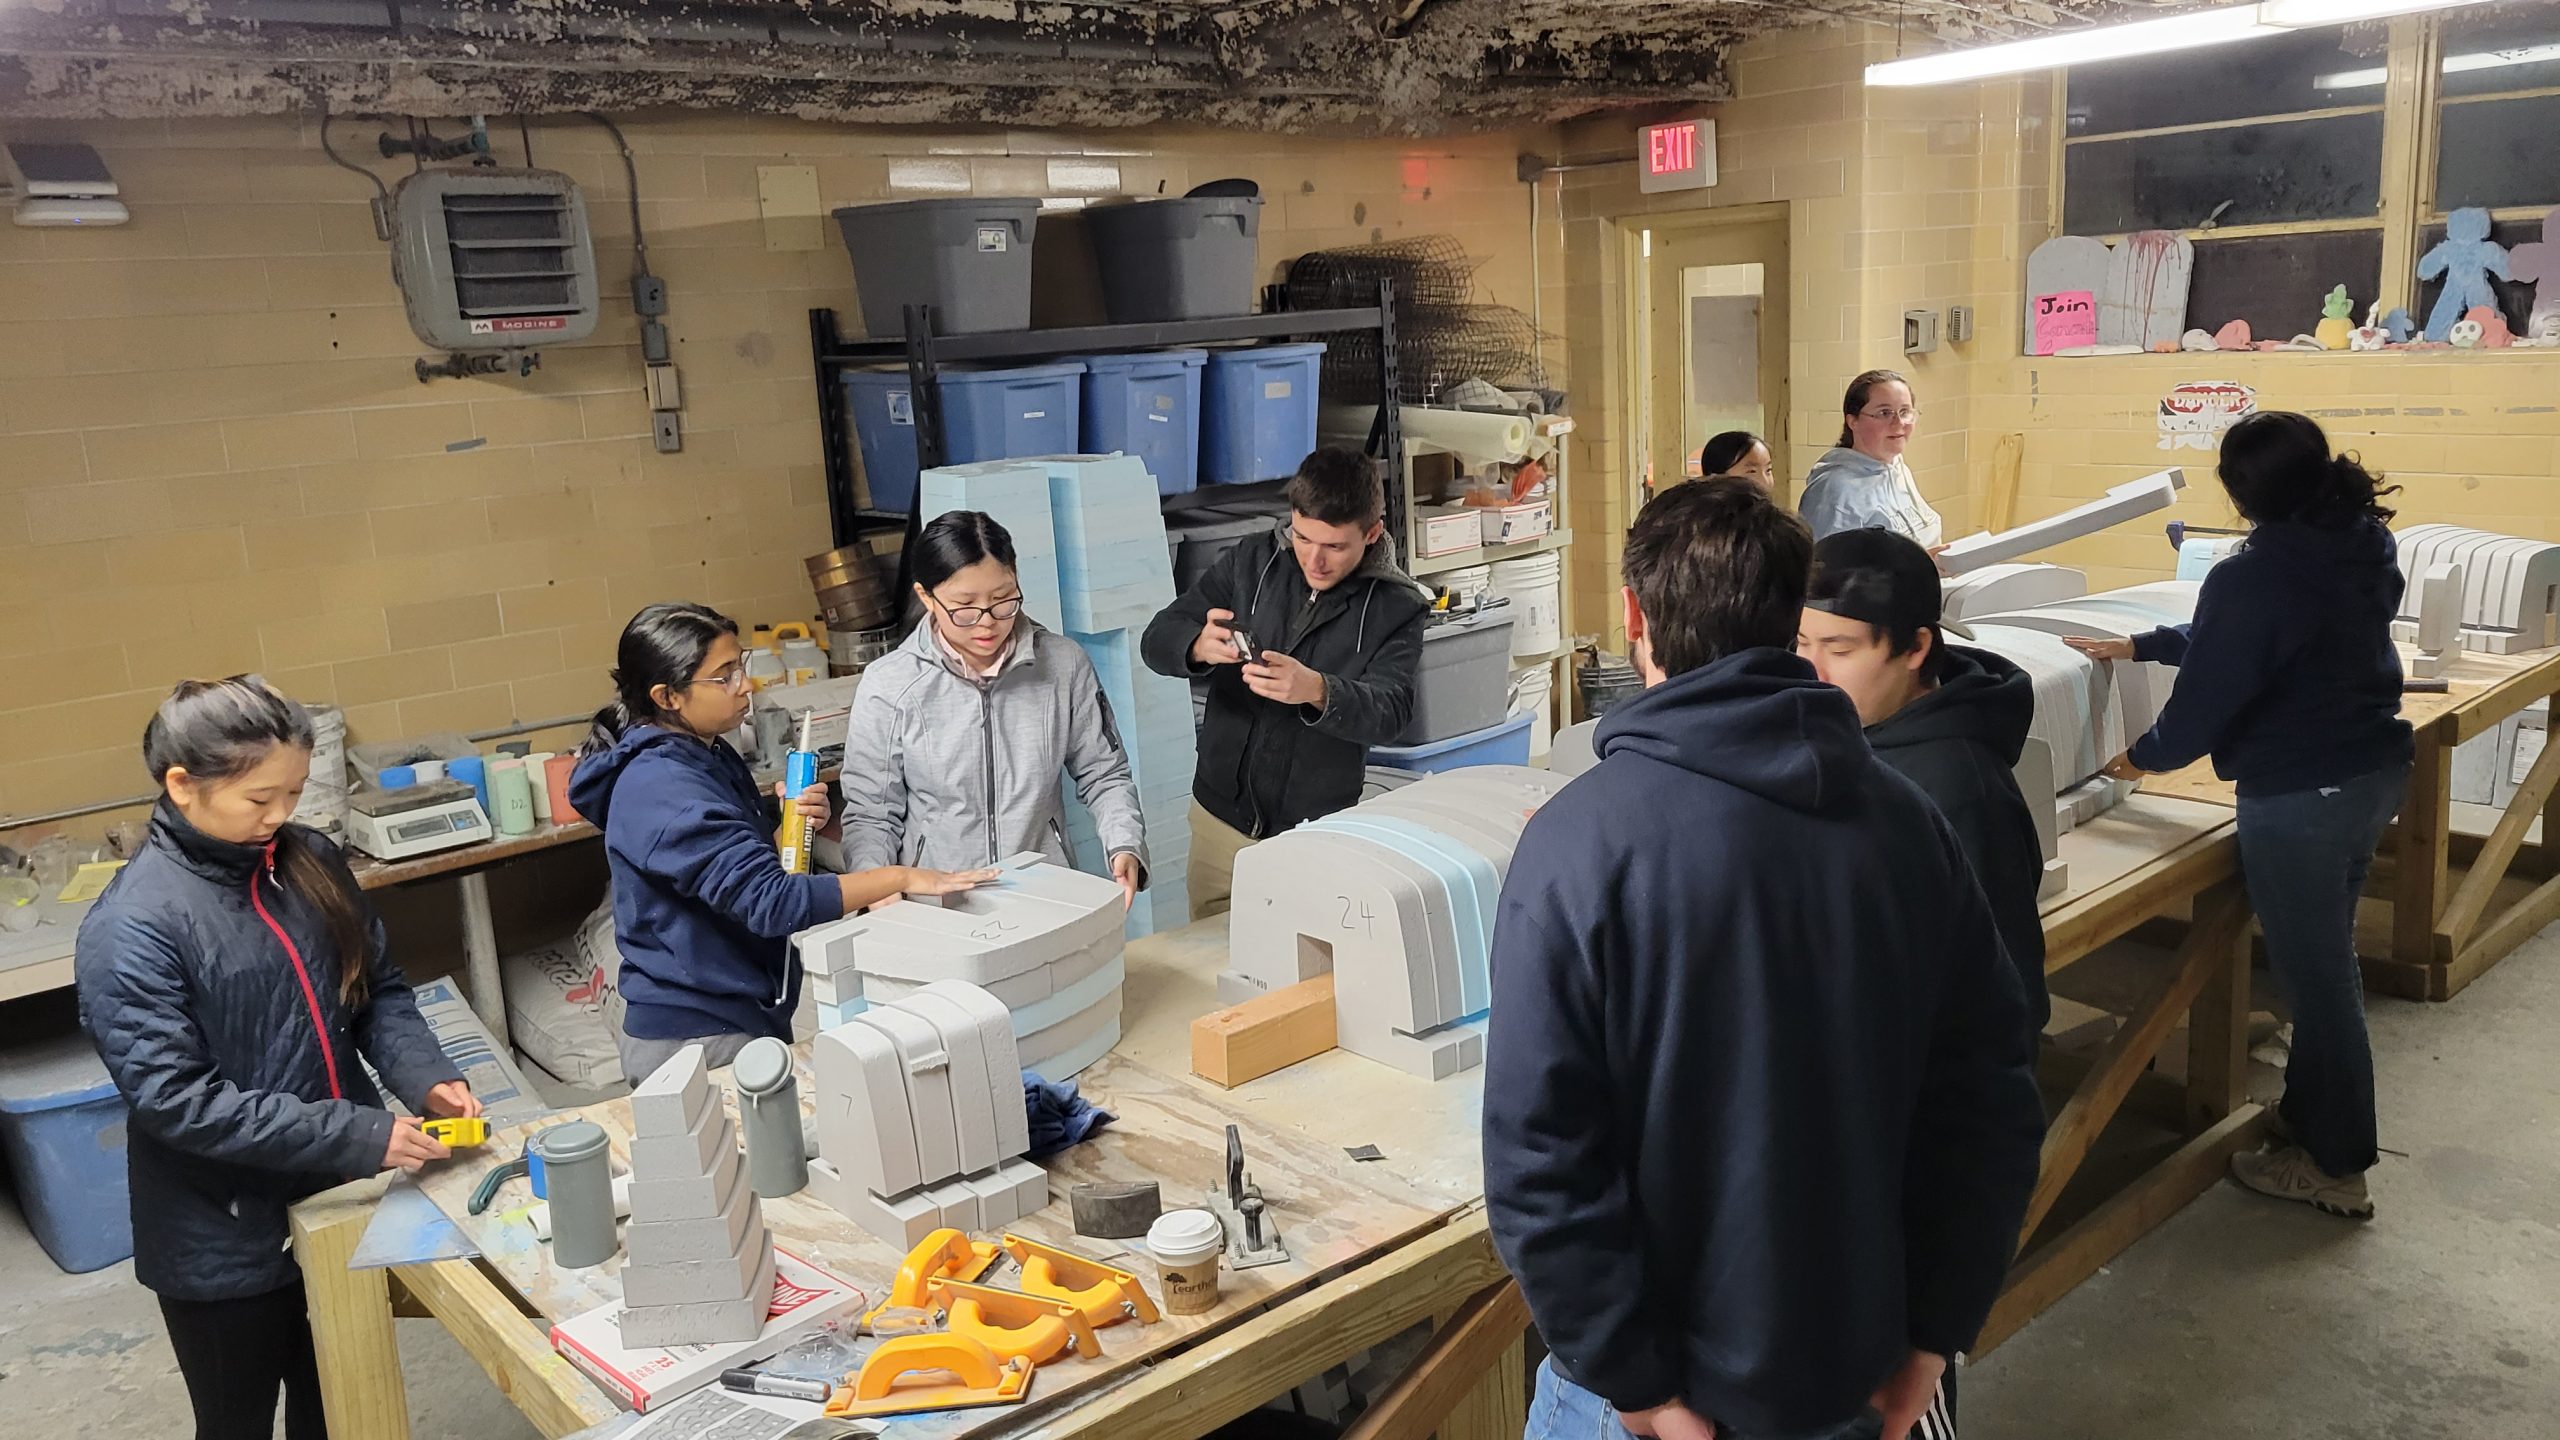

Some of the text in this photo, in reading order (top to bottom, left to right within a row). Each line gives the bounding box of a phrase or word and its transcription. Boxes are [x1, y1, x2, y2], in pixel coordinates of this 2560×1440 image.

[1650, 125, 1695, 173] EXIT
[2041, 297, 2089, 315] Join
[502, 319, 558, 329] MODINE
[1337, 896, 1375, 940] 24
[968, 919, 1020, 940] 23
